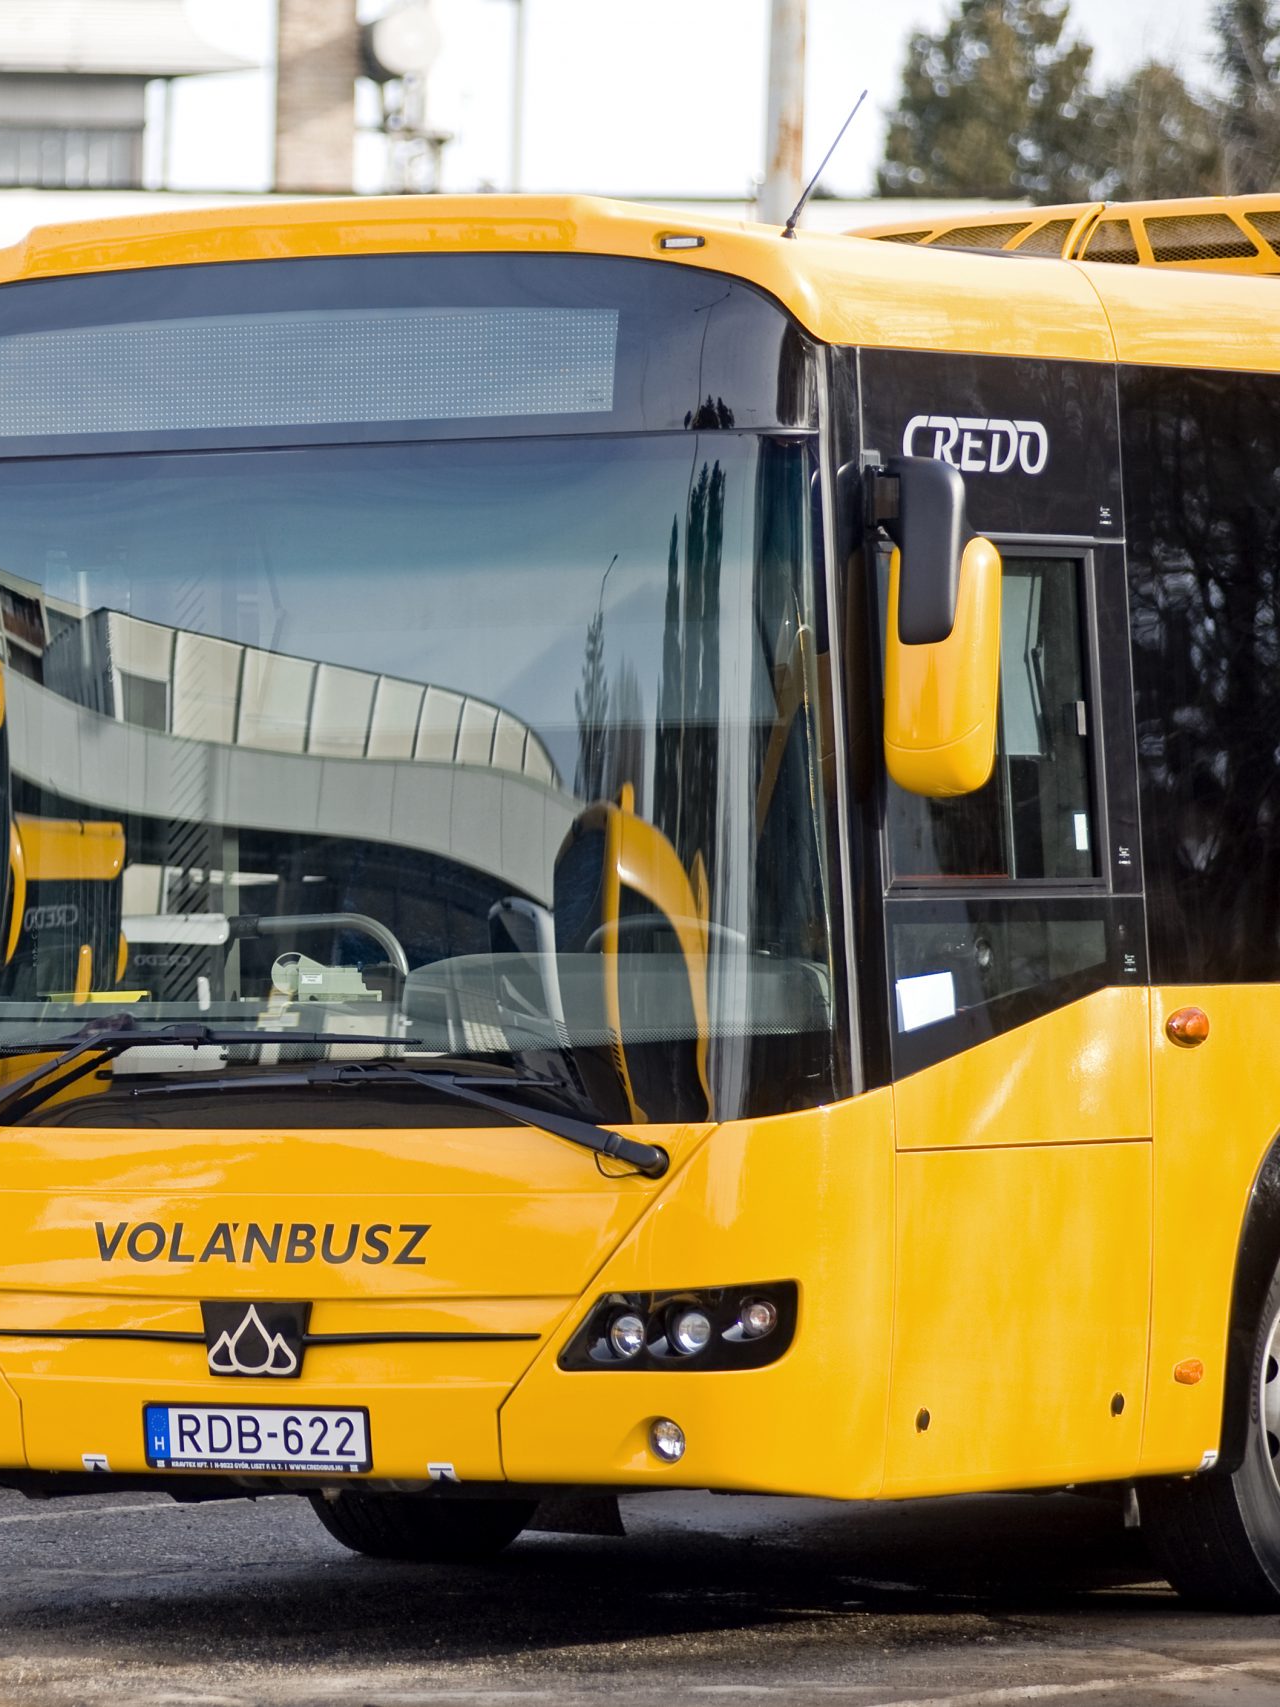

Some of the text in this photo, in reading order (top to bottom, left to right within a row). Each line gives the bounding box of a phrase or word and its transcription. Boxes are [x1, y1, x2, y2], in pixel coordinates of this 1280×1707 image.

[903, 415, 1048, 474] CREDO
[95, 1222, 432, 1265] VOLÁNBUSZ
[154, 1437, 165, 1450] H
[177, 1414, 356, 1456] RDB-622
